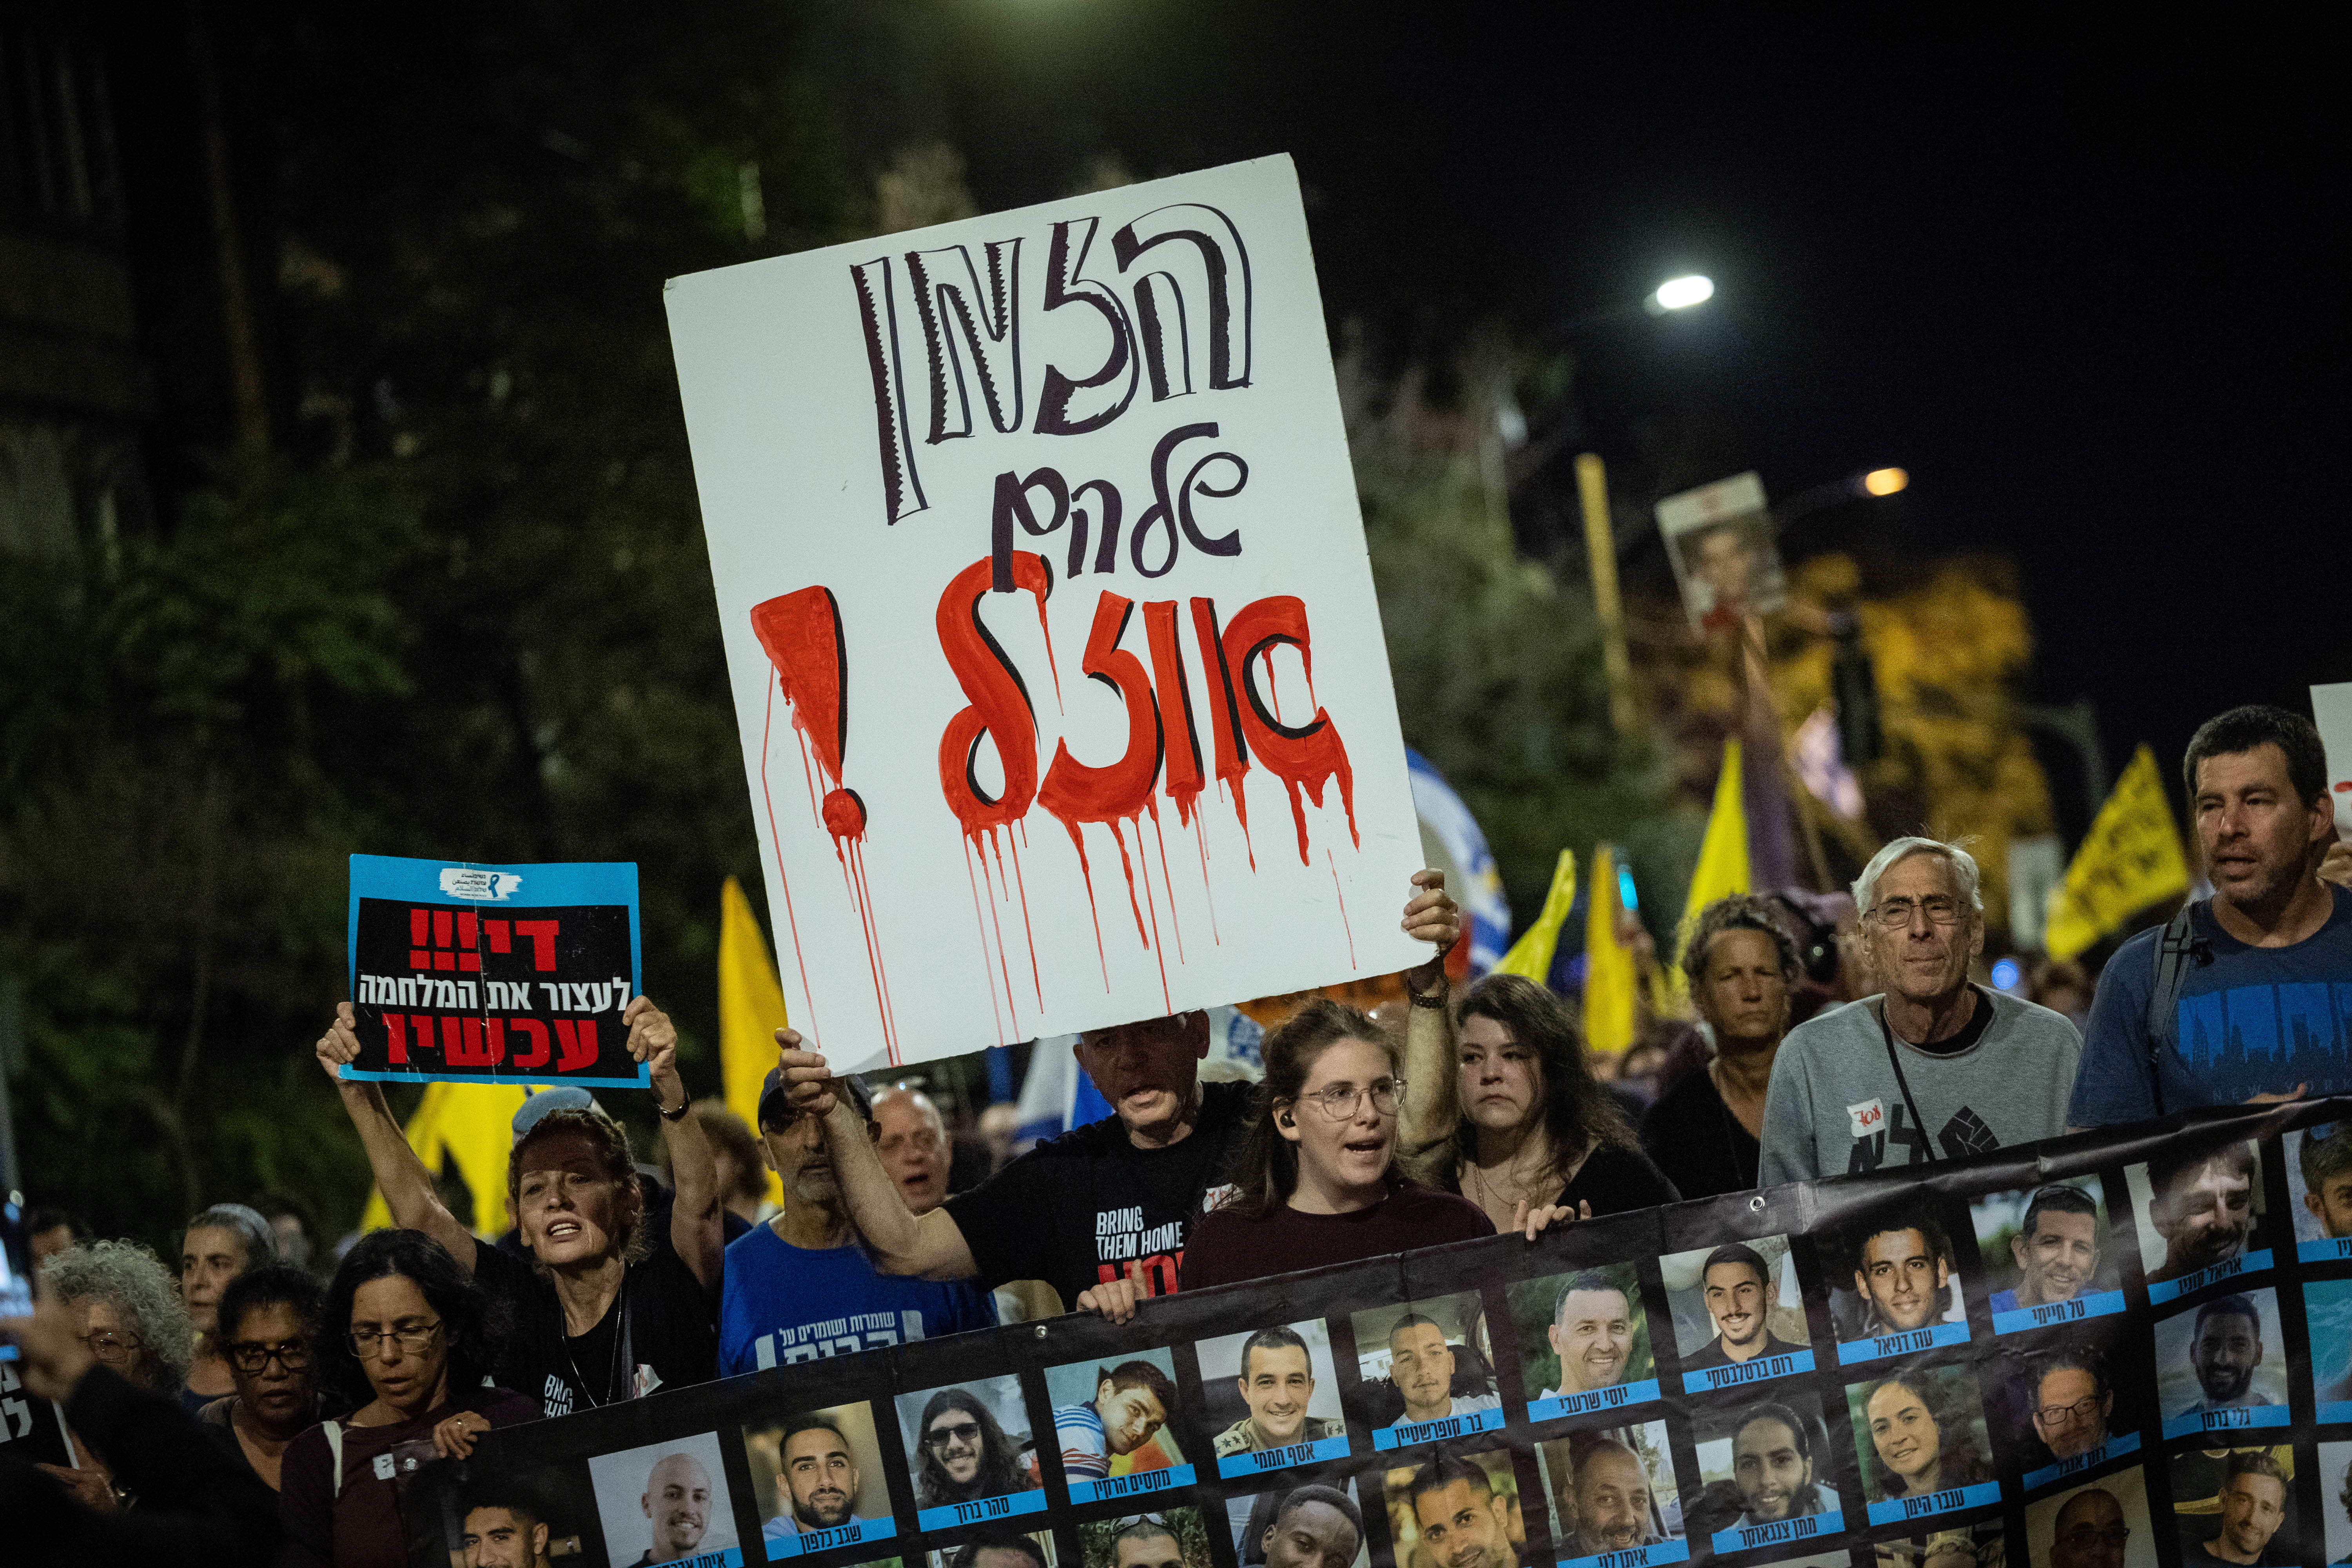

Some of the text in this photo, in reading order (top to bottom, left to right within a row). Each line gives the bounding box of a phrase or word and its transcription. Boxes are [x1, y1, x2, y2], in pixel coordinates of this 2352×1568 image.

[850, 203, 1254, 525] הזמן
[992, 422, 1249, 592] שלהם
[750, 550, 1359, 862] אוזל !
[410, 908, 559, 972] די!!!
[359, 974, 631, 1013] לעצור את המלחמה
[382, 1013, 599, 1073] עכשיו
[1095, 1205, 1144, 1235] BRING
[1095, 1220, 1184, 1261] THEM HOME
[2207, 1257, 2242, 1282] אריאל
[2032, 1299, 2085, 1324] טל חיימי
[779, 1311, 895, 1347] שומרות ושומרים על
[1873, 1329, 1933, 1356] עוז דניאל
[1706, 1356, 1793, 1389] רום ברסלבסקי
[1559, 1387, 1628, 1414] יוסי שרעבי
[1395, 1414, 1484, 1447] בר קופרשטיין
[2201, 1407, 2250, 1431] גלי ברמן
[1252, 1443, 1315, 1469] אסף חממי
[1093, 1469, 1171, 1500] מקסים הרקין
[953, 1497, 1010, 1524] סהר ברוך
[1902, 1489, 1964, 1519] ענבר הימן
[799, 1524, 862, 1555] שגב כלפון
[1738, 1517, 1817, 1548] מתן צנגאוקר
[1597, 1548, 1648, 1568] איתן לוי
